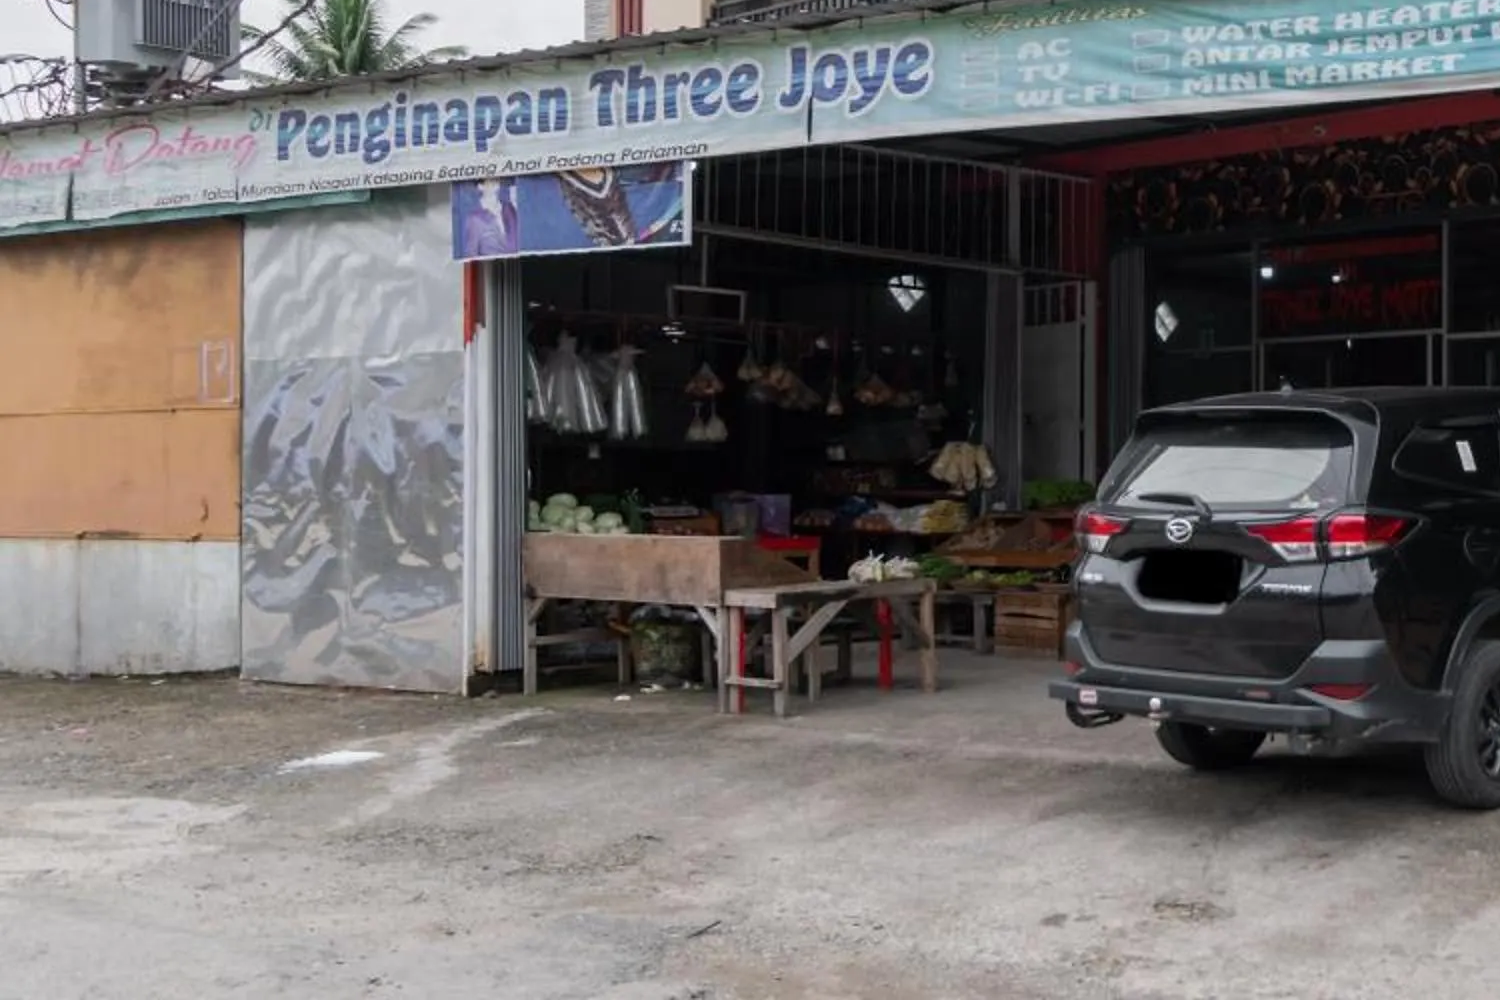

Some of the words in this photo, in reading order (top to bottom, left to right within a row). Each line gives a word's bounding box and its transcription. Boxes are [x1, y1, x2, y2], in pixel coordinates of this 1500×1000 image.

[1181, 13, 1321, 44] WATER
[1181, 40, 1311, 69] ANTAR
[1321, 23, 1481, 58] JEMPUT
[1016, 38, 1072, 61] AC
[1016, 62, 1069, 84] TV
[1181, 70, 1271, 98] MINI
[1285, 53, 1467, 86] MARKET
[276, 85, 568, 165] Penginapan
[590, 62, 760, 127] Three
[780, 41, 931, 114] Joye
[1015, 84, 1126, 108] WI-FI
[249, 106, 273, 132] di
[105, 120, 256, 176] Datang
[242, 181, 306, 197] Mundam
[309, 175, 361, 192] Nagari
[363, 169, 434, 187] Kataping
[438, 162, 497, 180] Batang
[502, 157, 542, 173] Anai
[547, 151, 615, 169] Padang
[622, 142, 709, 162] Pariaman
